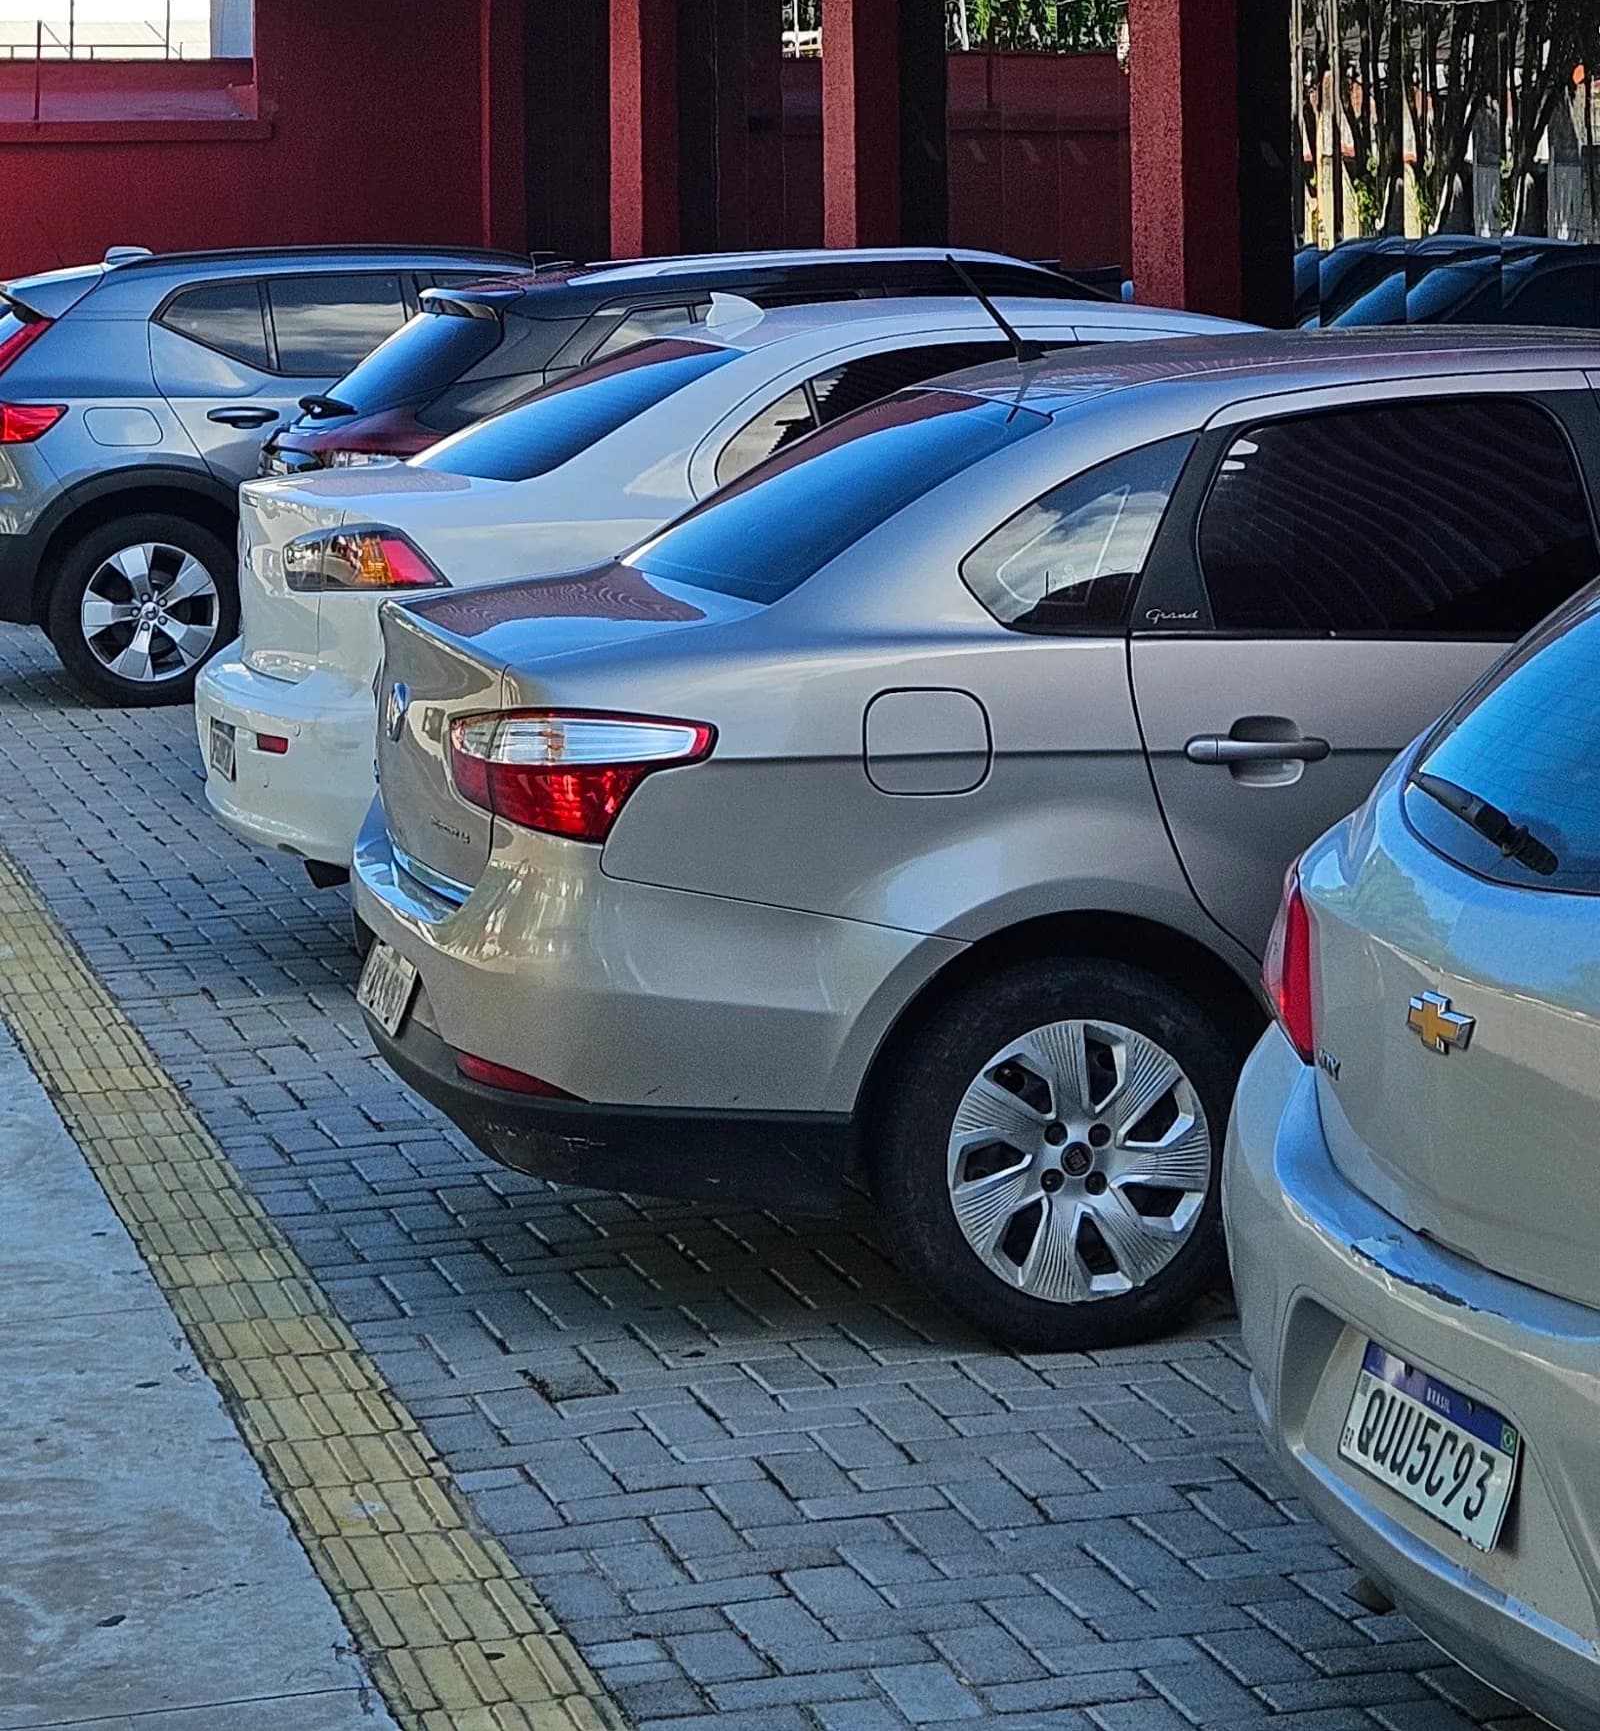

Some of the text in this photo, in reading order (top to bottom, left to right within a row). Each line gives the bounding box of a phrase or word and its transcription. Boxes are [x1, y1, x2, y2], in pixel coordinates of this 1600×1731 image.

[1145, 608, 1199, 624] Grand
[1426, 1387, 1450, 1414] BRASIL
[1357, 1387, 1496, 1522] QUU5C93
